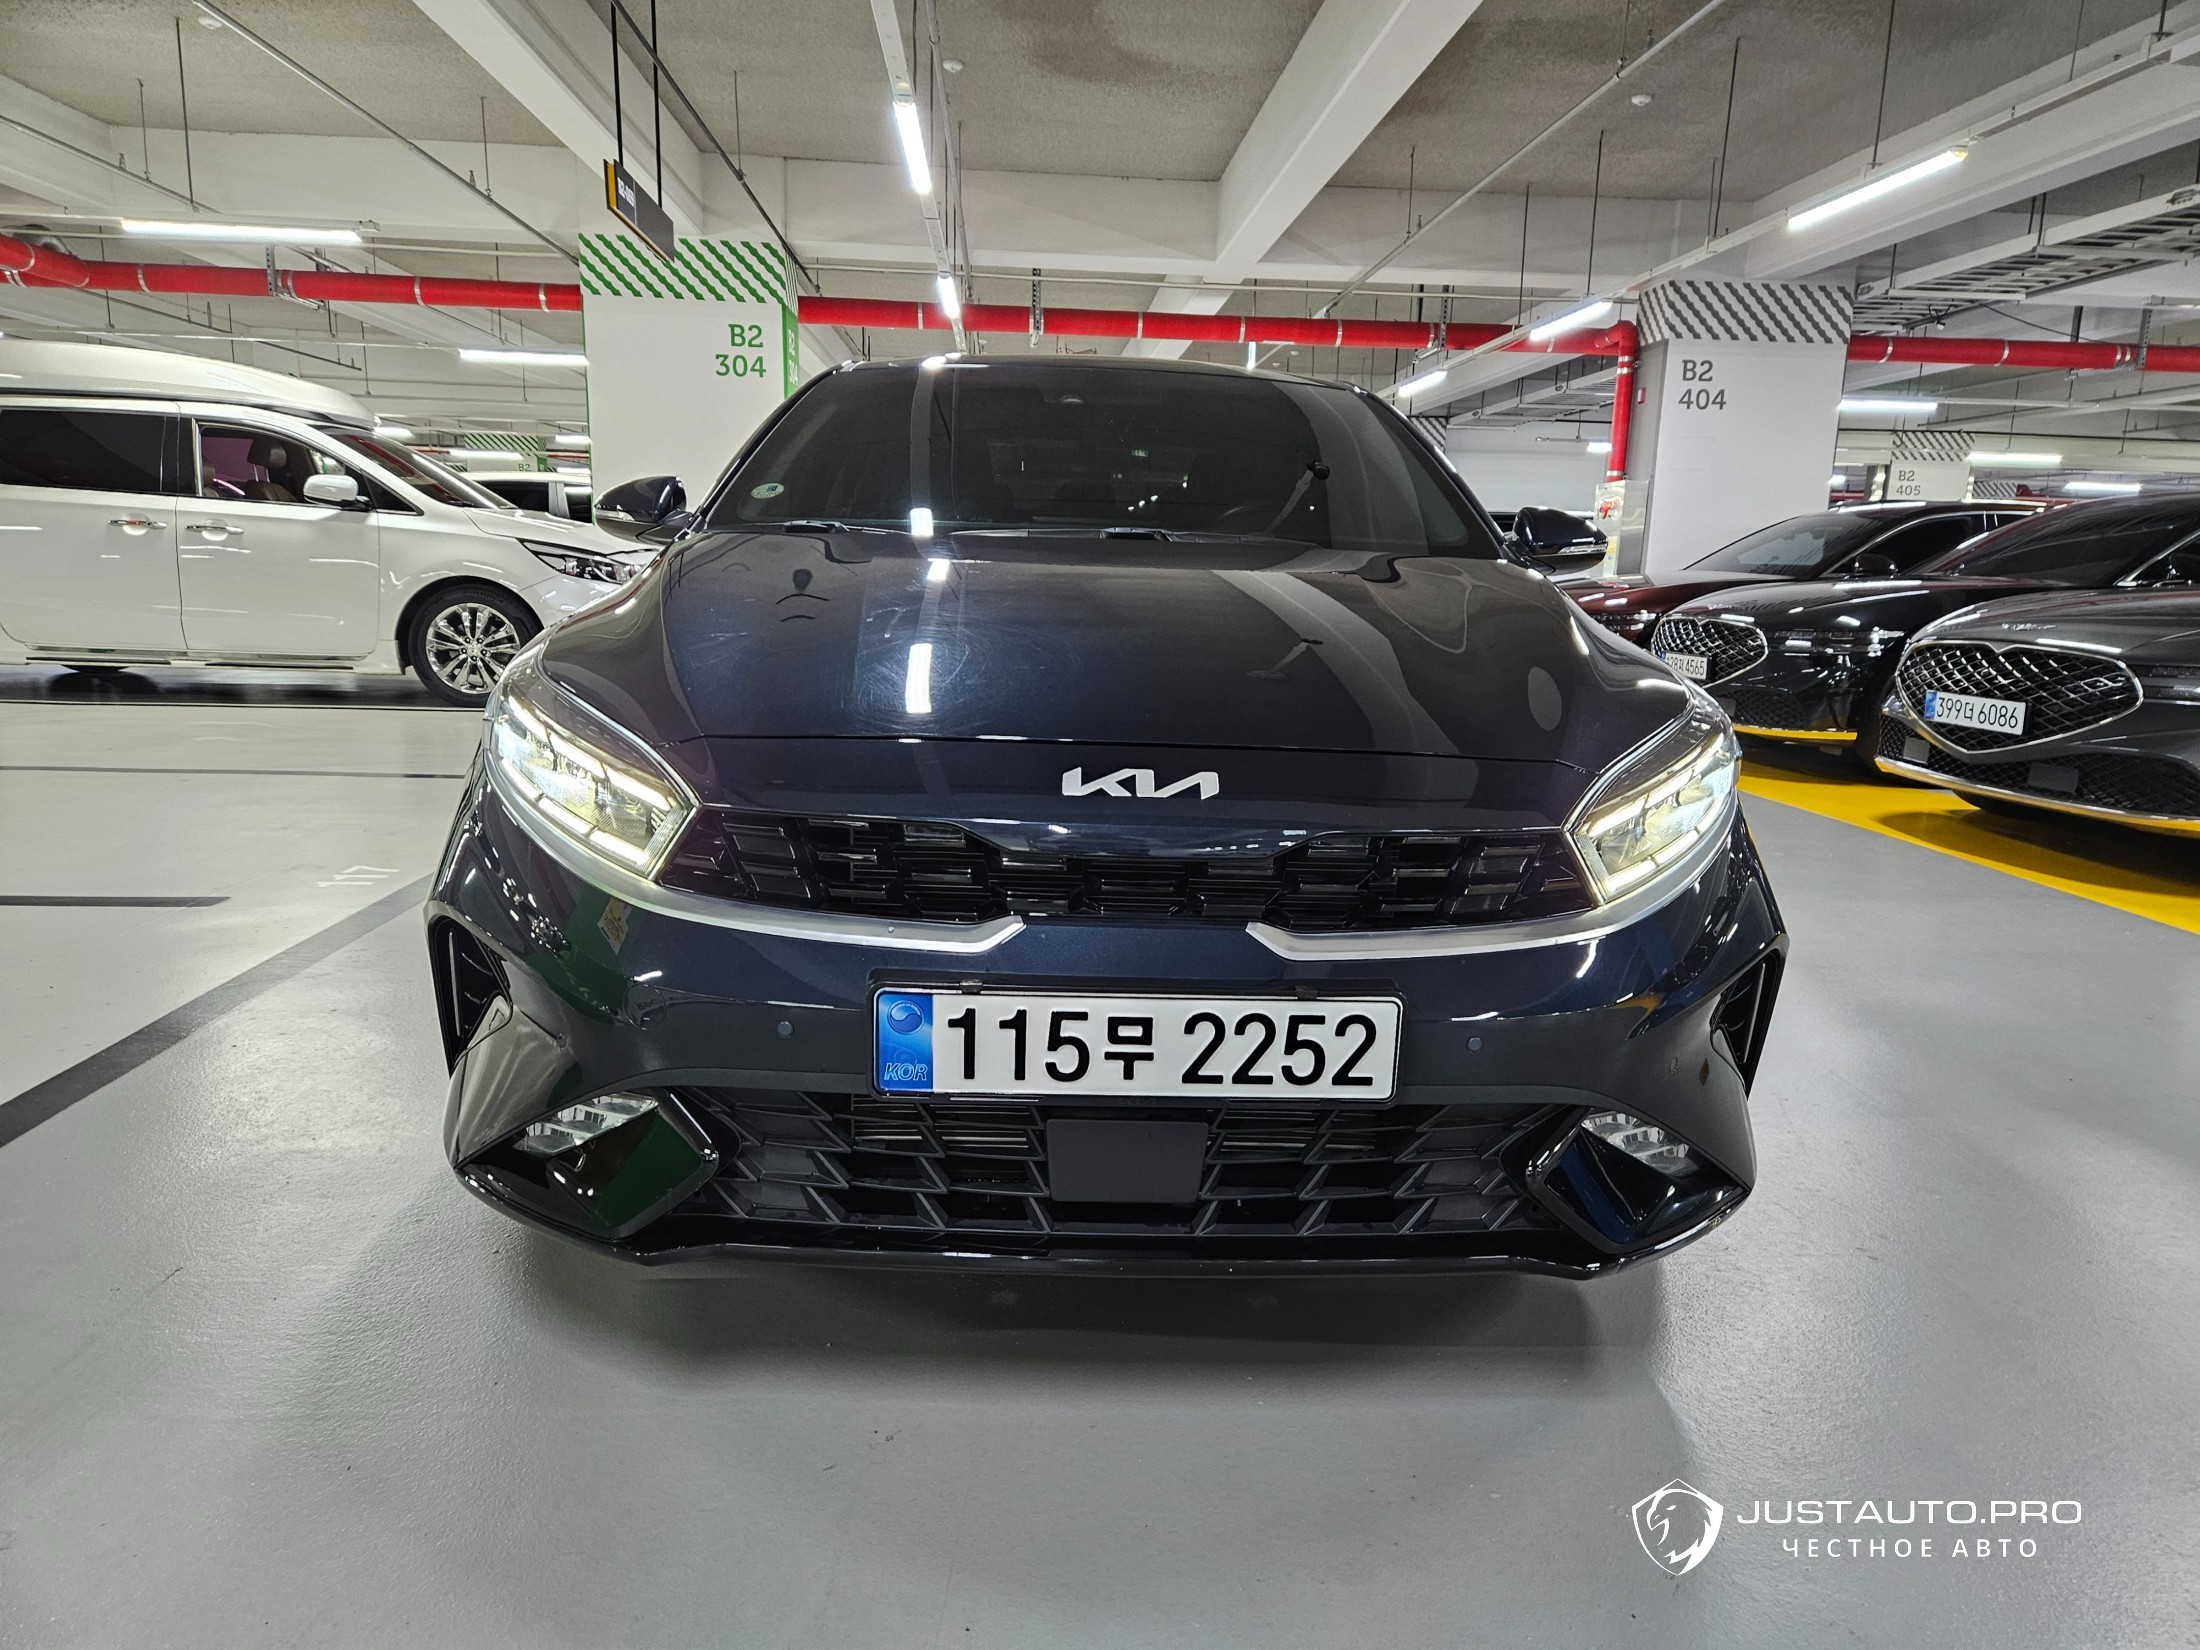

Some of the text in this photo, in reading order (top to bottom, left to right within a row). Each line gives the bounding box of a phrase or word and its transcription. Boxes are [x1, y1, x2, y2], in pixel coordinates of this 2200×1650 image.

[728, 323, 763, 348] B2
[715, 353, 767, 378] 304
[1682, 359, 1713, 382] B2
[1678, 388, 1727, 410] 404
[518, 463, 531, 472] B2
[1898, 470, 1915, 482] B2
[1896, 485, 1921, 496] 405
[1685, 658, 1705, 676] 4565
[1937, 697, 2018, 729] 399더 6086
[1062, 766, 1219, 800] KIA
[947, 1007, 1377, 1087] 115무 2252
[883, 1062, 928, 1081] KOR
